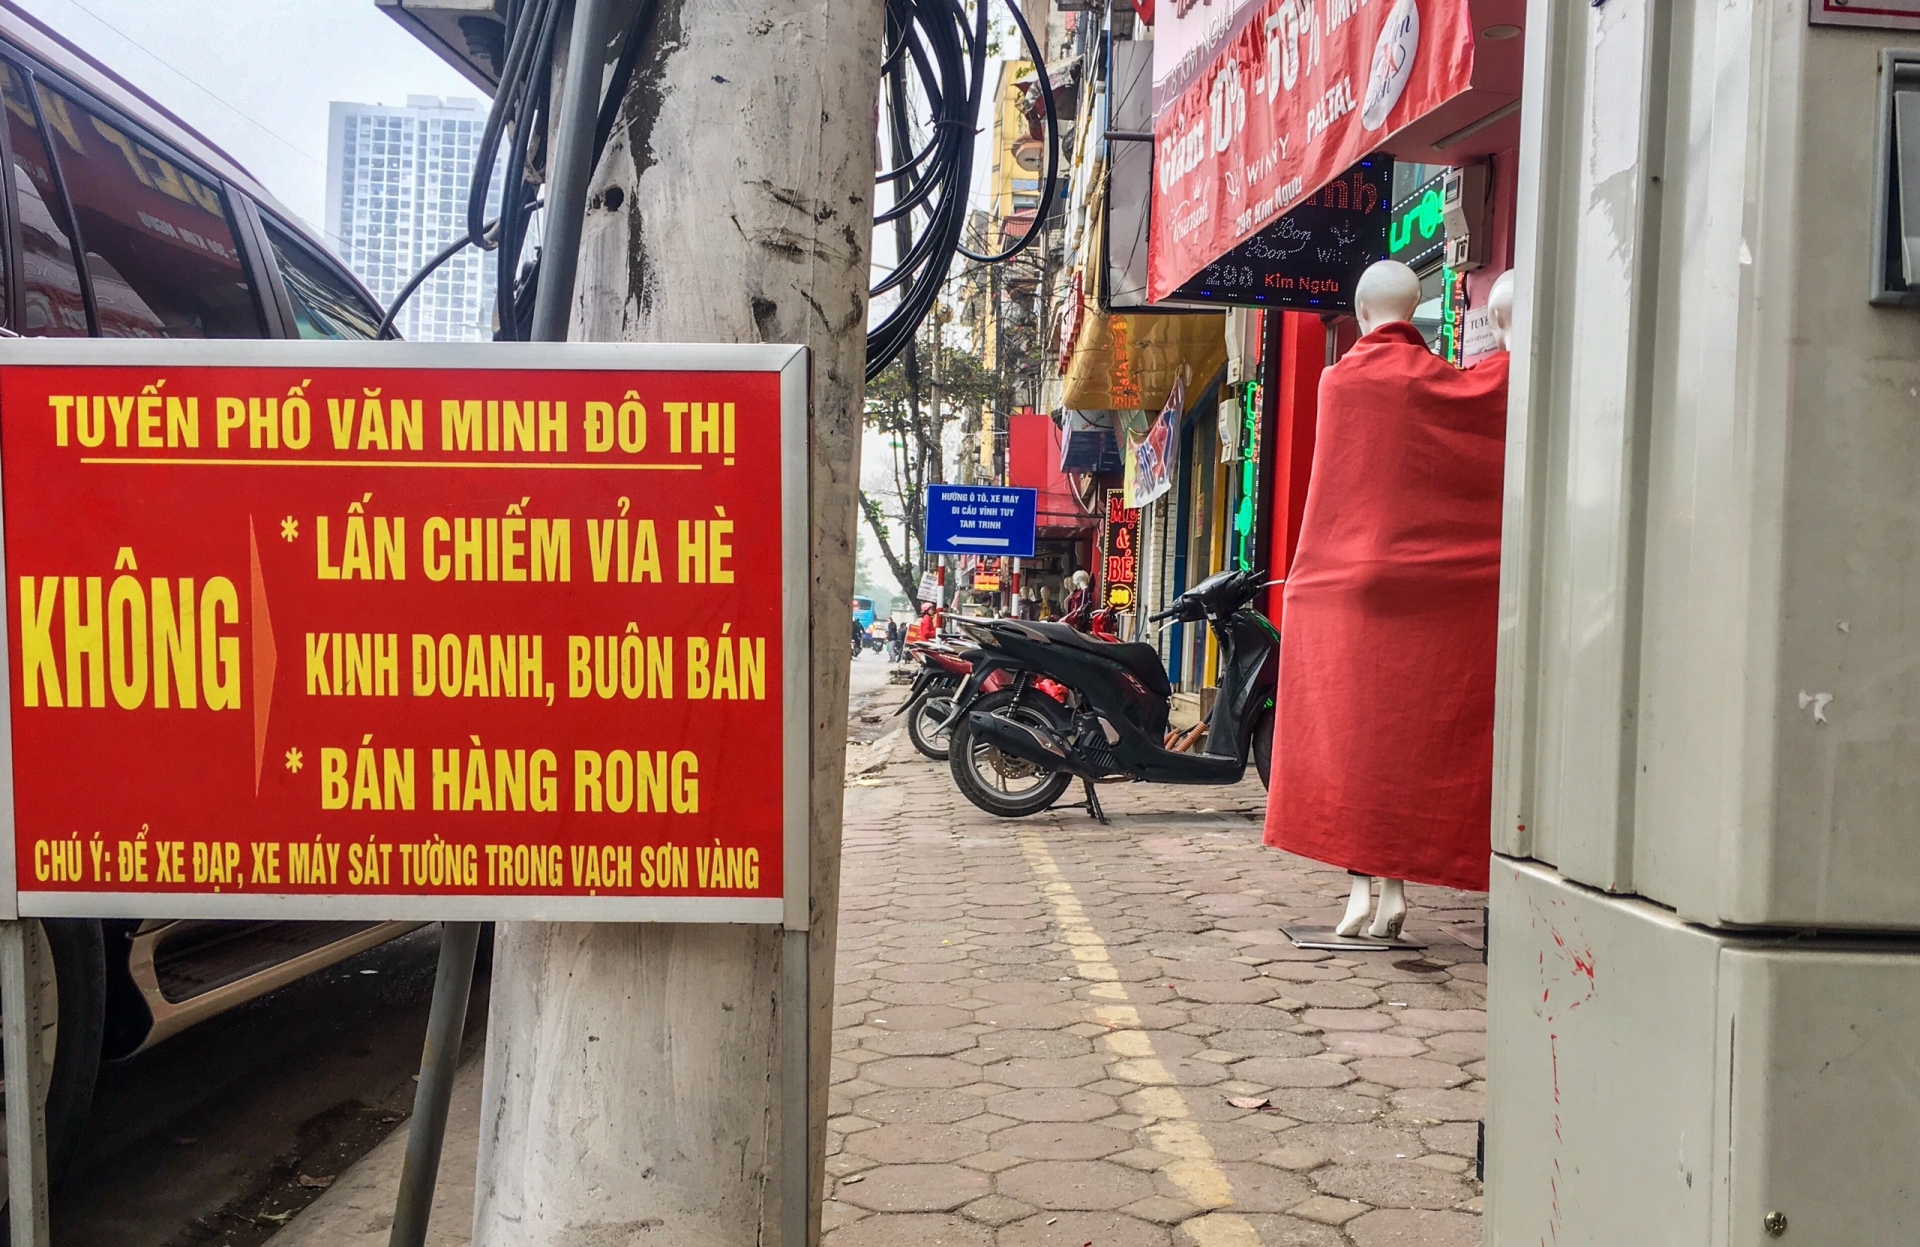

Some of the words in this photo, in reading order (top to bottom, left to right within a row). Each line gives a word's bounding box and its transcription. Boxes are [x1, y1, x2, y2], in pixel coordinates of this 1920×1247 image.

[1307, 75, 1357, 145] PALTAL
[50, 380, 198, 448] TUYẾN
[217, 382, 311, 450] PHỐ
[328, 388, 423, 452] VĂN
[442, 401, 567, 453] MINH
[584, 391, 647, 454] ĐÔ
[664, 402, 735, 466] THỊ
[951, 506, 960, 515] ĐI
[1000, 508, 1015, 517] TUY
[960, 519, 976, 529] TAM
[978, 520, 1001, 530] TRINH
[990, 495, 1000, 503] XE
[1002, 493, 1020, 504] MÁY
[318, 494, 406, 580] LẤN
[424, 497, 571, 582] CHIẾM
[588, 497, 662, 584] VỈA
[679, 507, 734, 584] HÈ
[1108, 549, 1135, 583] BÉ
[1116, 528, 1131, 549] &
[21, 547, 241, 711] KHÔNG
[307, 634, 399, 697] KINH
[413, 635, 555, 706] DOANH,
[569, 622, 673, 699] BUÔN
[688, 623, 765, 700] BÁN
[322, 735, 415, 811] BÁN
[433, 736, 558, 813] HÀNG
[575, 751, 699, 814] RONG
[36, 833, 82, 882] CHÚ
[91, 832, 111, 882] Ý:
[118, 824, 148, 882] ĐỂ
[157, 843, 185, 883] XE
[193, 842, 244, 893] ĐẠP,
[252, 843, 281, 884] XE
[289, 834, 340, 884] MÁY
[349, 835, 393, 886] SÁT
[400, 834, 478, 886] TƯỜNG
[486, 845, 563, 887] TRONG
[571, 846, 632, 896] VẠCH
[641, 842, 689, 888] SƠN
[697, 838, 759, 889] VÀNG
